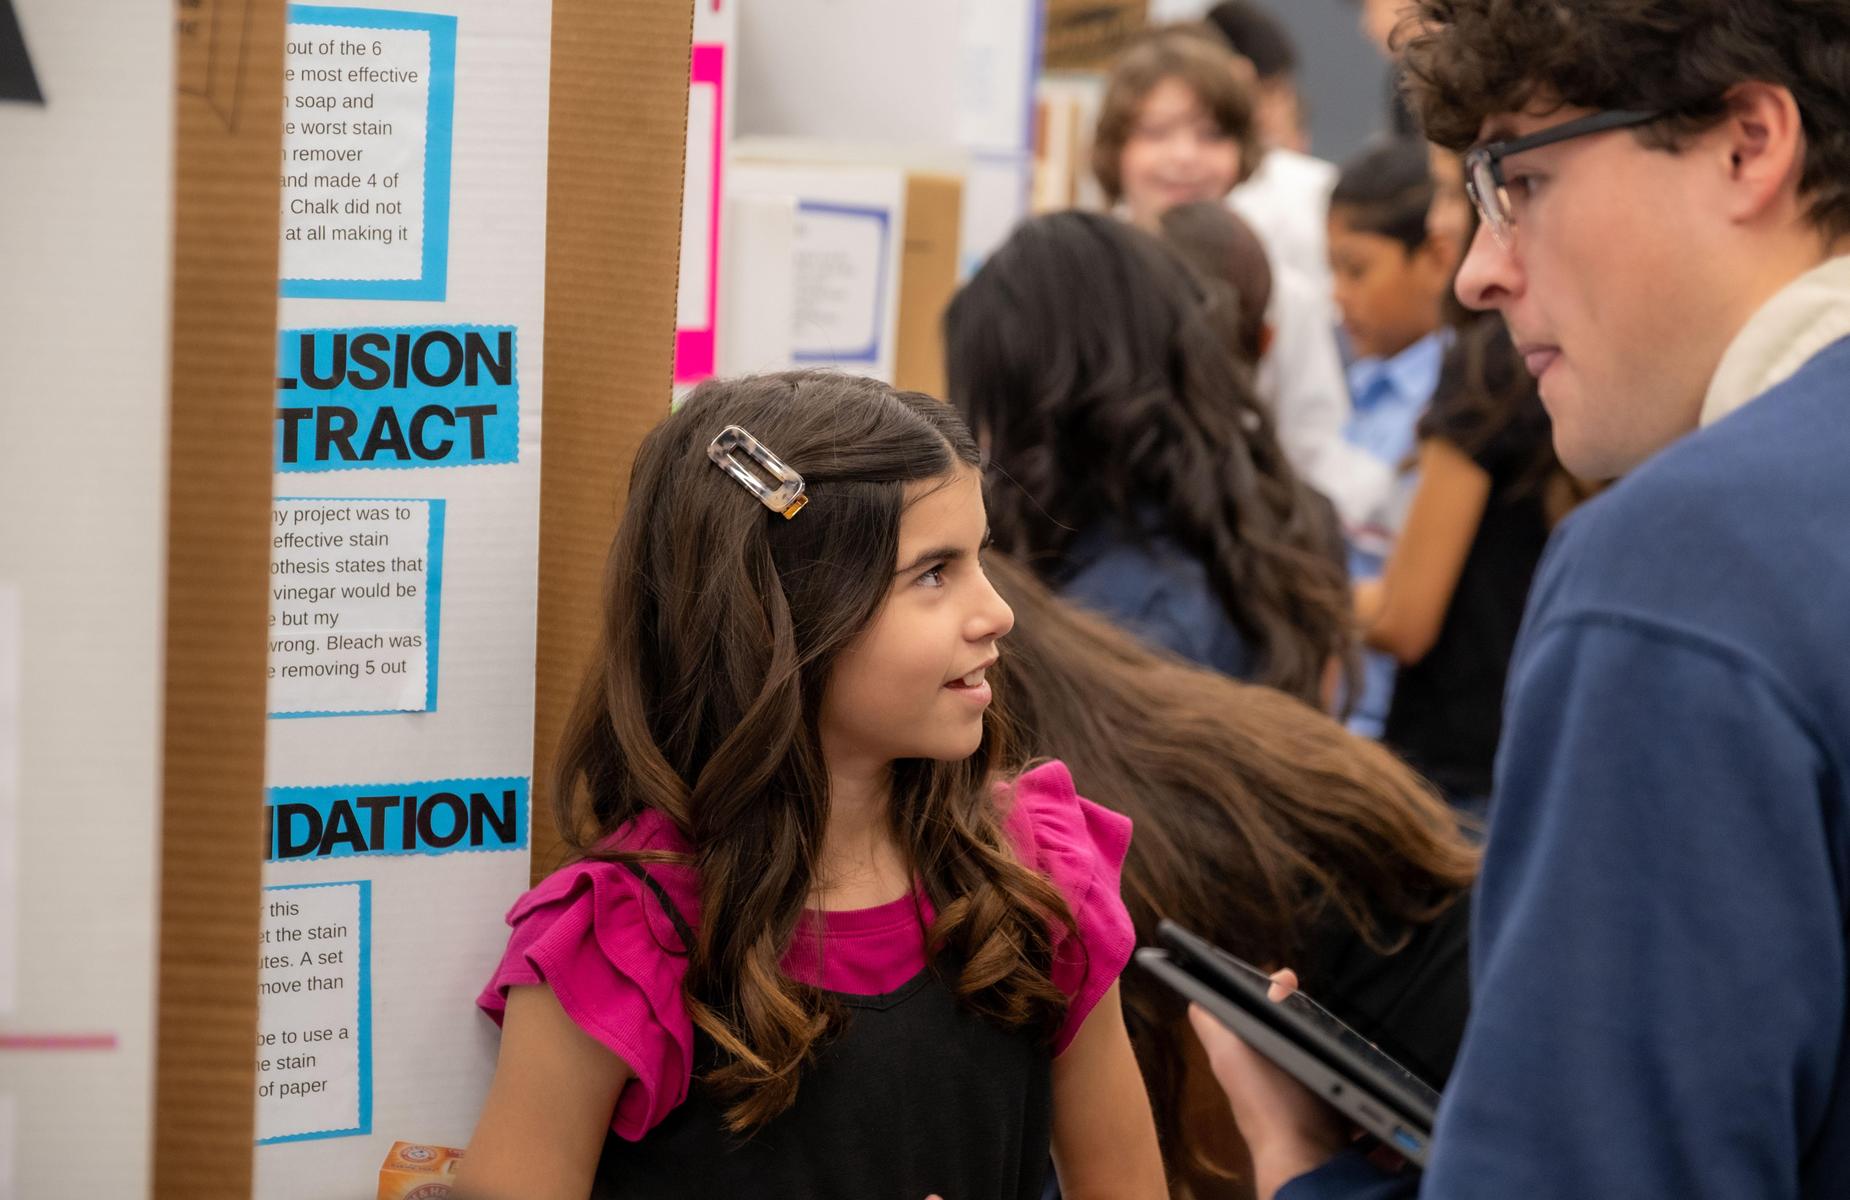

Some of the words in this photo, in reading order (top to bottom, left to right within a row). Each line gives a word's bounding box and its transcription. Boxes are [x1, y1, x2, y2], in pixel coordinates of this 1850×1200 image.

[286, 40, 313, 55] out
[318, 40, 335, 55] of
[340, 40, 366, 56] the
[372, 41, 382, 56] 6
[301, 67, 342, 82] most
[347, 67, 418, 83] effective
[295, 95, 336, 112] soap
[342, 93, 374, 109] and
[300, 121, 347, 135] worst
[352, 120, 392, 135] stain
[293, 148, 363, 161] remover
[314, 172, 361, 188] made
[367, 173, 377, 188] 4
[383, 172, 399, 188] of
[290, 198, 339, 214] Chalk
[344, 199, 369, 214] did
[375, 200, 402, 214] not
[285, 226, 301, 240] at
[306, 225, 326, 240] all
[332, 225, 392, 245] making
[398, 225, 408, 240] it
[274, 404, 497, 464] TRACT
[294, 506, 351, 525] project
[356, 508, 390, 521] was
[395, 507, 411, 520] to
[273, 531, 343, 548] effective
[349, 530, 389, 547] stain
[335, 559, 386, 573] states
[391, 557, 423, 572] that
[273, 585, 336, 603] vinegar
[341, 582, 390, 598] would
[396, 582, 417, 597] be
[282, 611, 308, 626] but
[314, 612, 339, 629] my
[327, 634, 383, 650] Bleach
[389, 635, 422, 648] was
[281, 660, 359, 679] removing
[365, 660, 375, 675] 5
[381, 659, 407, 674] out
[270, 901, 299, 917] this
[276, 927, 302, 942] the
[307, 923, 347, 940] stain
[300, 951, 313, 966] A
[318, 950, 343, 965] set
[307, 975, 343, 991] than
[281, 1030, 297, 1044] to
[303, 1028, 333, 1042] use
[338, 1027, 349, 1039] a
[276, 1053, 316, 1070] stain
[259, 1080, 275, 1097] of
[280, 1079, 328, 1099] paper
